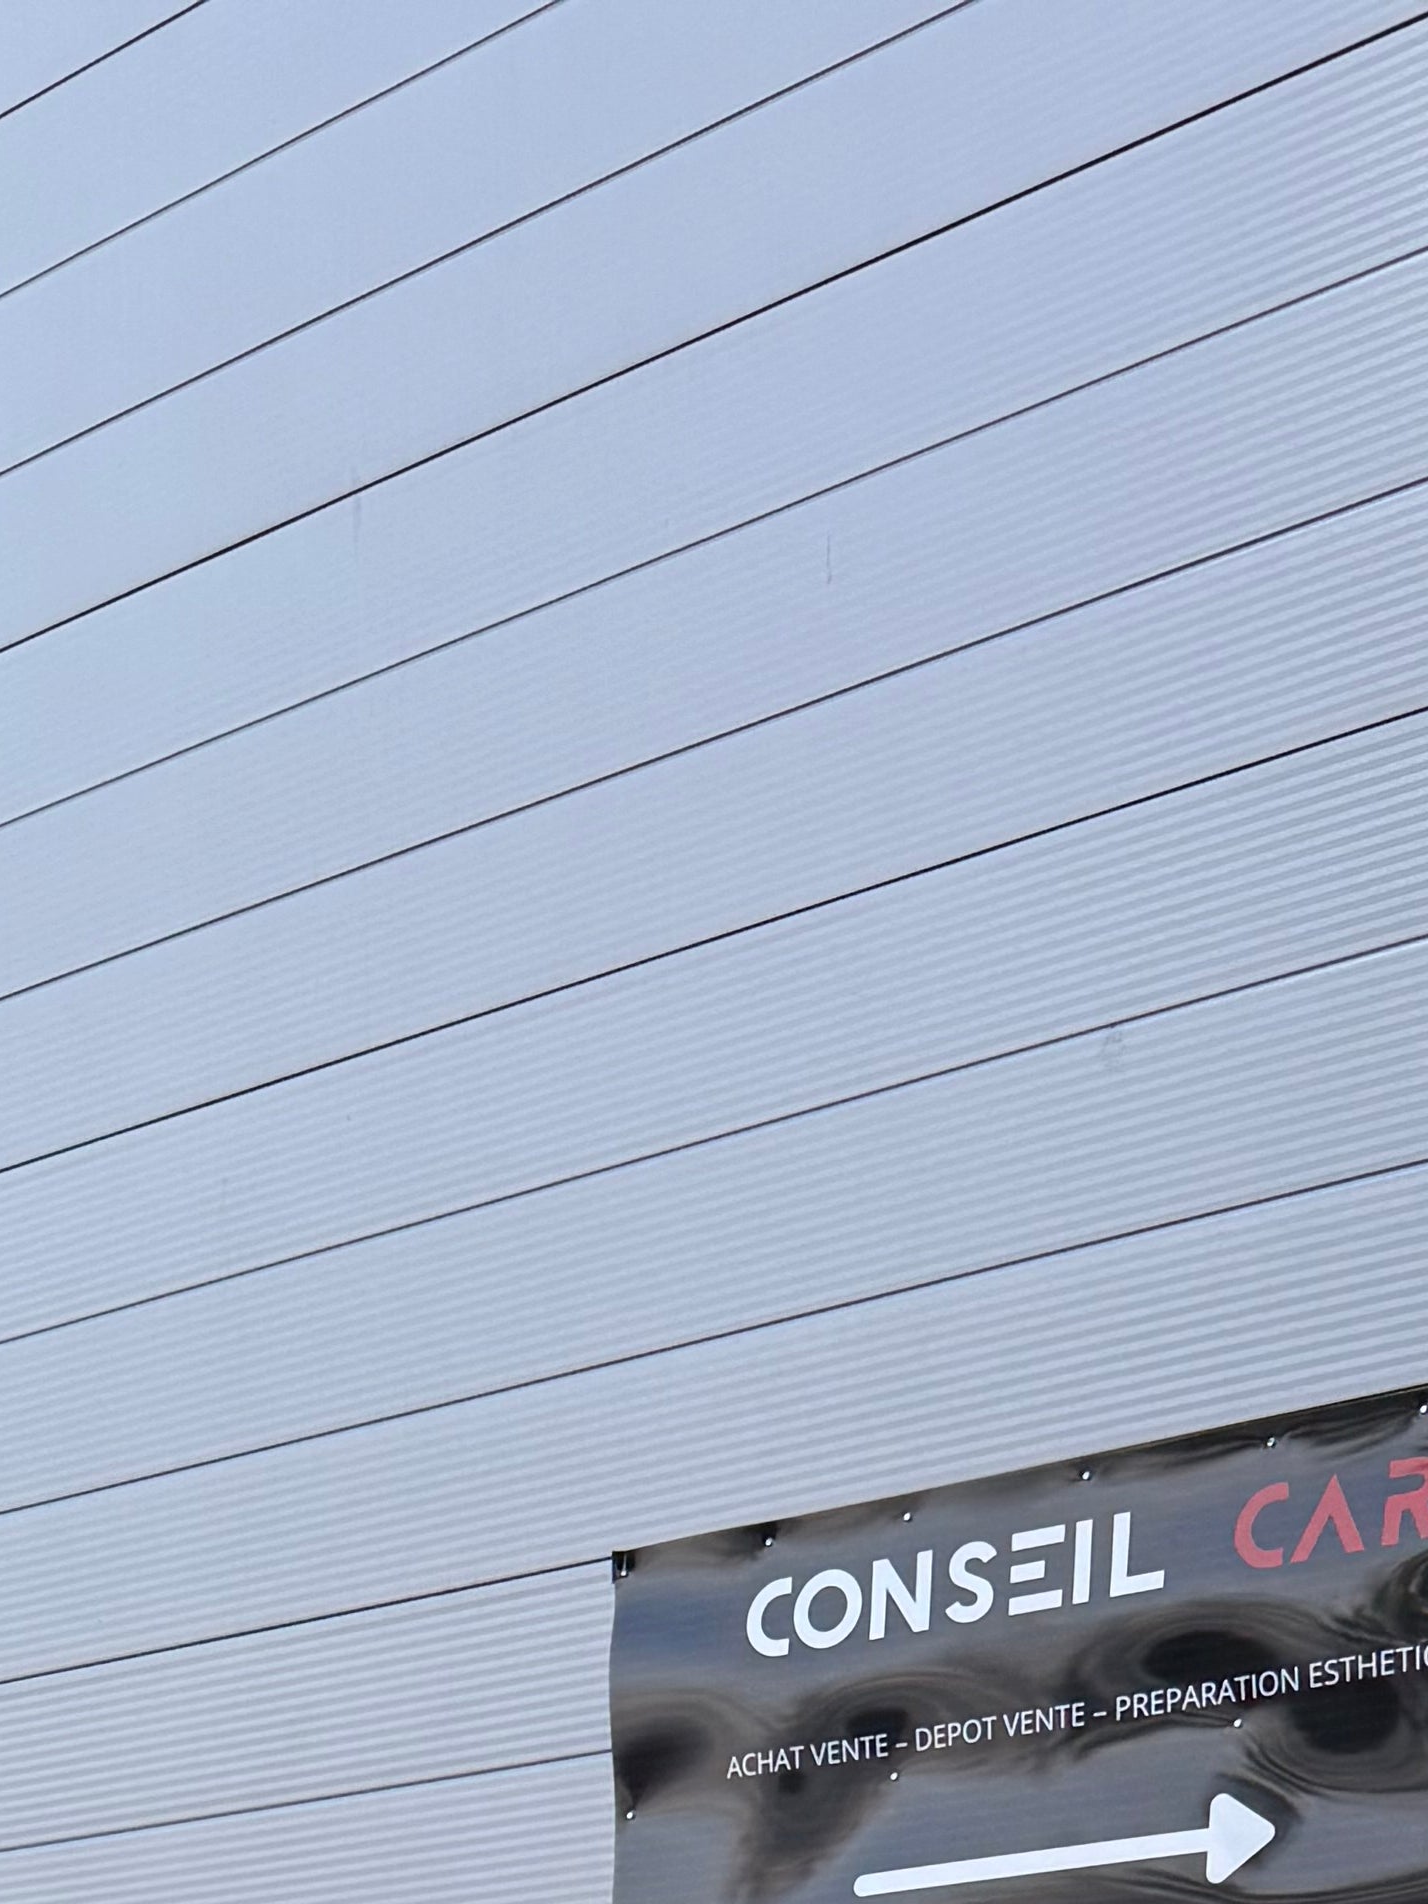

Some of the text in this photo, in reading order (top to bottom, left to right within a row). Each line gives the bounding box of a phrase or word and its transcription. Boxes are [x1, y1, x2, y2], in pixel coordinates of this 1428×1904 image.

[746, 1511, 1165, 1658] CONSEIL
[726, 1745, 805, 1779] ACHAT
[810, 1733, 889, 1767] VENTE
[915, 1715, 997, 1752] DEPOT
[1002, 1702, 1085, 1738] VENTE
[1115, 1665, 1300, 1722] PREPARATION
